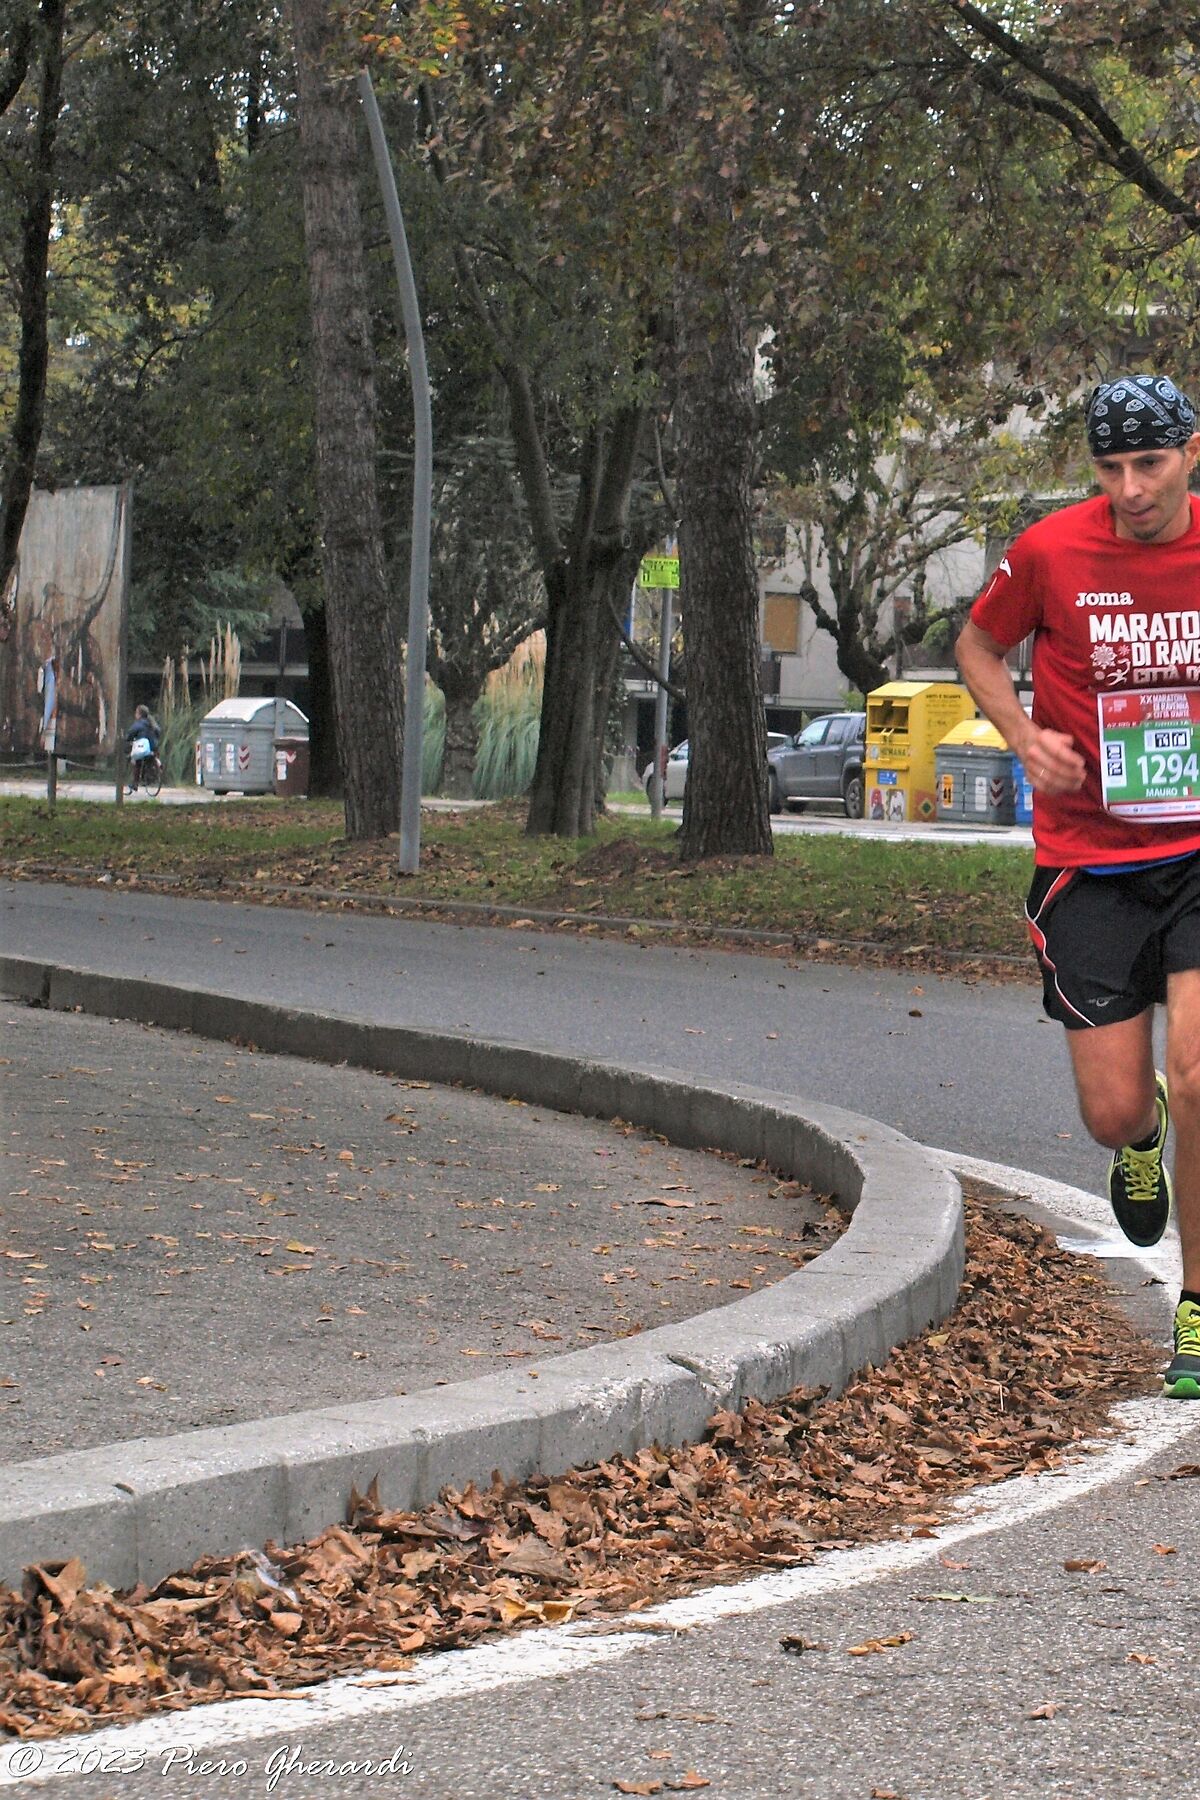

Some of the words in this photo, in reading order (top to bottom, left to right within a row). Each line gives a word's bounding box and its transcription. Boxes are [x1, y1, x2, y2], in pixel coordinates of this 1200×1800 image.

[1131, 642, 1151, 667] DI
[1153, 693, 1187, 703] MARATONA
[1137, 753, 1199, 785] 1294
[1146, 786, 1178, 797] MAURO
